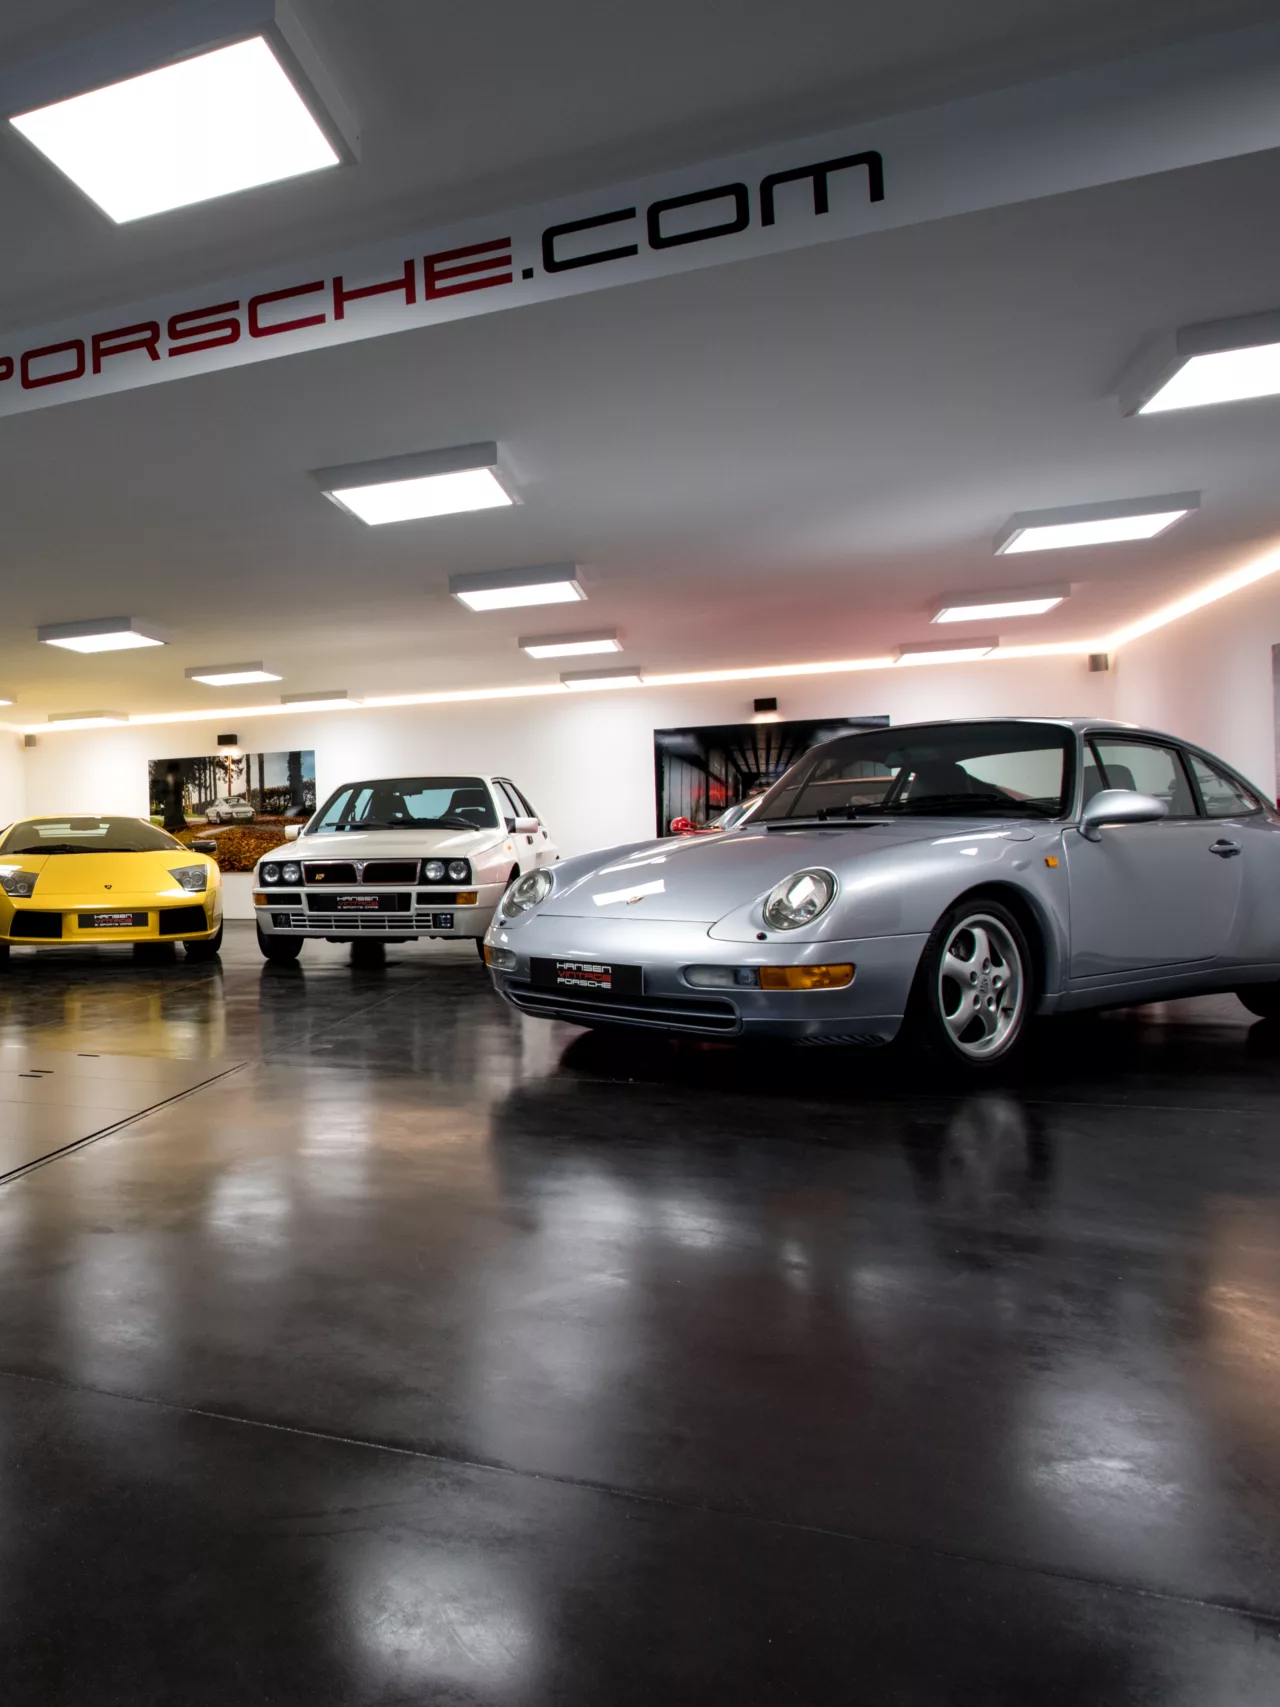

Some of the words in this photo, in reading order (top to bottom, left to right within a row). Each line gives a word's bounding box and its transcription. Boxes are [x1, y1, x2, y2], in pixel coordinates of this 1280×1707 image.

[557, 962, 612, 974] HANSEN
[557, 970, 612, 982] VINTAGE
[557, 977, 612, 989] PORSCHE
